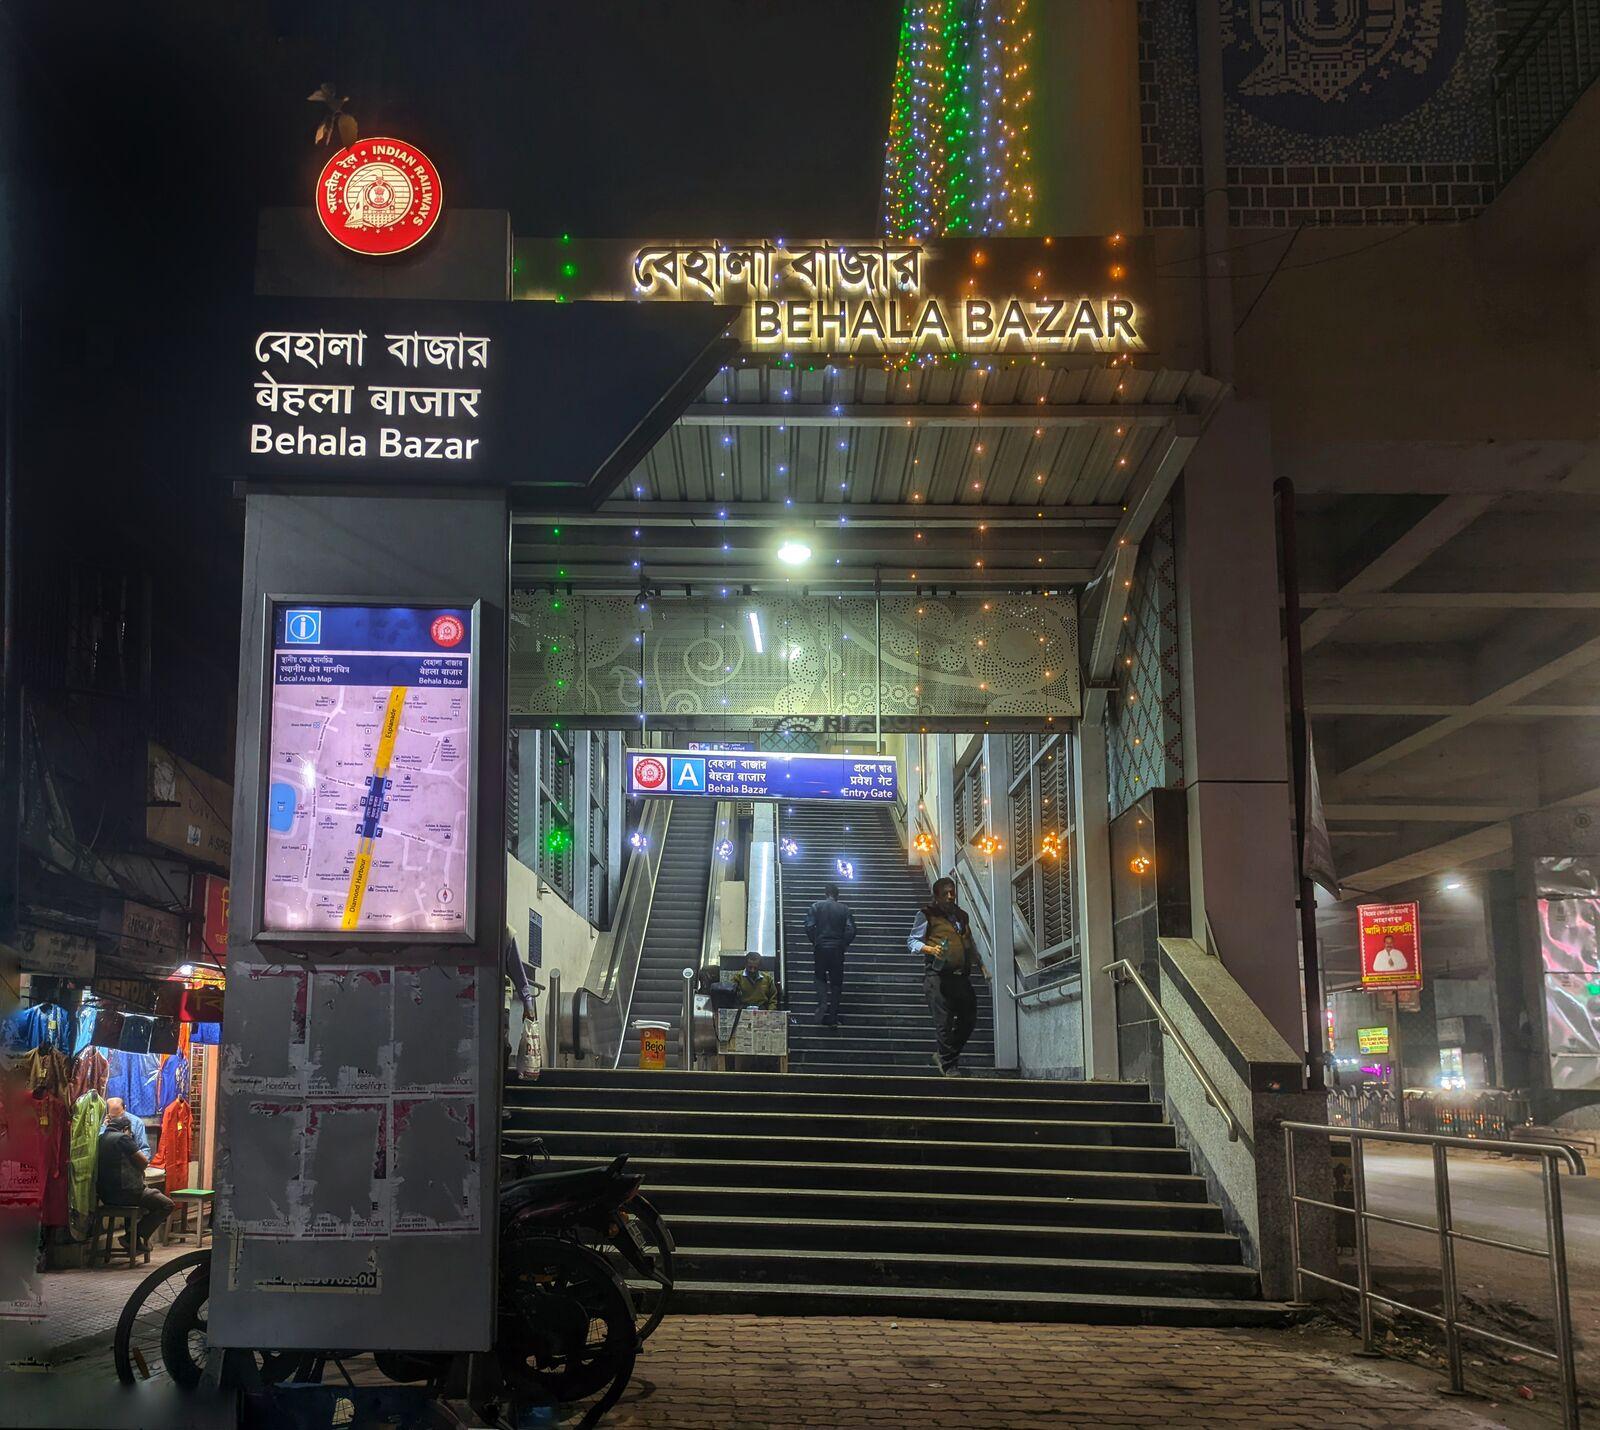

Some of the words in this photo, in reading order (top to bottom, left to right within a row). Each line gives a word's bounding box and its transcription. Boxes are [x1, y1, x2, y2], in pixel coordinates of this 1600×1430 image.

[325, 170, 343, 214] भारतीय
[336, 153, 358, 169] रेल
[372, 145, 417, 167] INDIAN
[412, 165, 433, 227] RAILWAYS
[635, 240, 777, 297] বেহালা
[787, 240, 924, 292] বাজার
[754, 300, 951, 339] BEHALA
[965, 300, 1138, 339] BAZAR
[254, 328, 367, 369] বেহালা
[384, 330, 491, 370] বাজার
[254, 370, 355, 416] बेहला
[368, 385, 482, 418] बाजार
[250, 424, 367, 458] Behala
[379, 427, 480, 460] Bazar
[279, 674, 298, 682] Local
[317, 675, 333, 684] Map
[418, 677, 442, 685] Behala
[443, 677, 463, 686] Bazar
[385, 708, 397, 738] Esplanade
[678, 763, 699, 787] A
[708, 759, 736, 769] বেহালা
[740, 760, 768, 770] বাজার
[708, 783, 739, 793] Behala
[741, 784, 768, 794] Bazar
[843, 787, 869, 799] Entry
[870, 788, 893, 798] Gate
[850, 774, 873, 785] प्रवेश
[877, 774, 893, 786] गेट
[356, 858, 366, 884] Harbour
